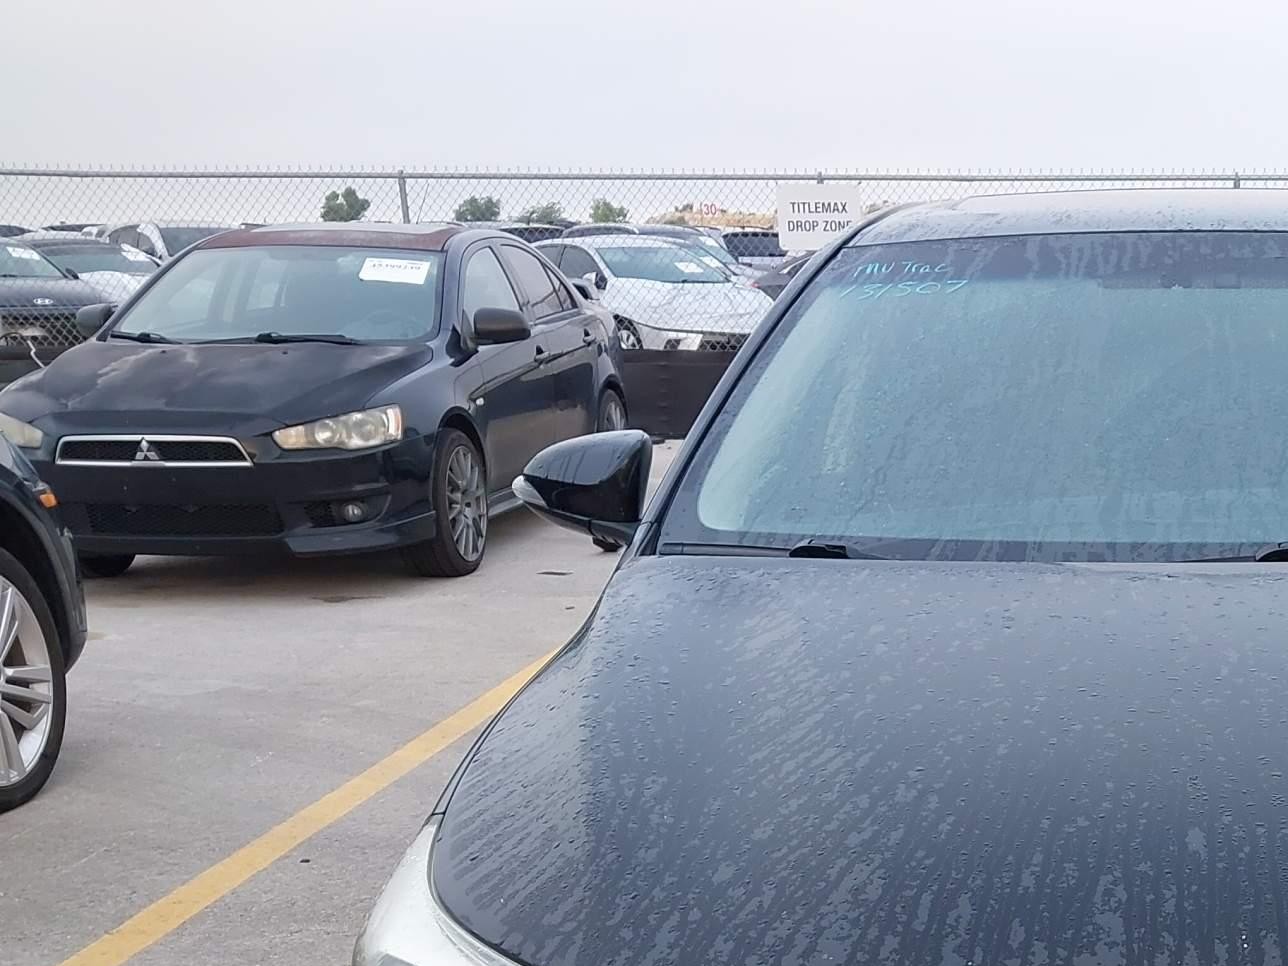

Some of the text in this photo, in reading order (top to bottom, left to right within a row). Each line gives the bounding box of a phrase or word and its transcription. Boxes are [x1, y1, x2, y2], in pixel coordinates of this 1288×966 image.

[703, 203, 717, 216] 30
[790, 201, 848, 214] TITLEMAX
[787, 220, 819, 232] DROP
